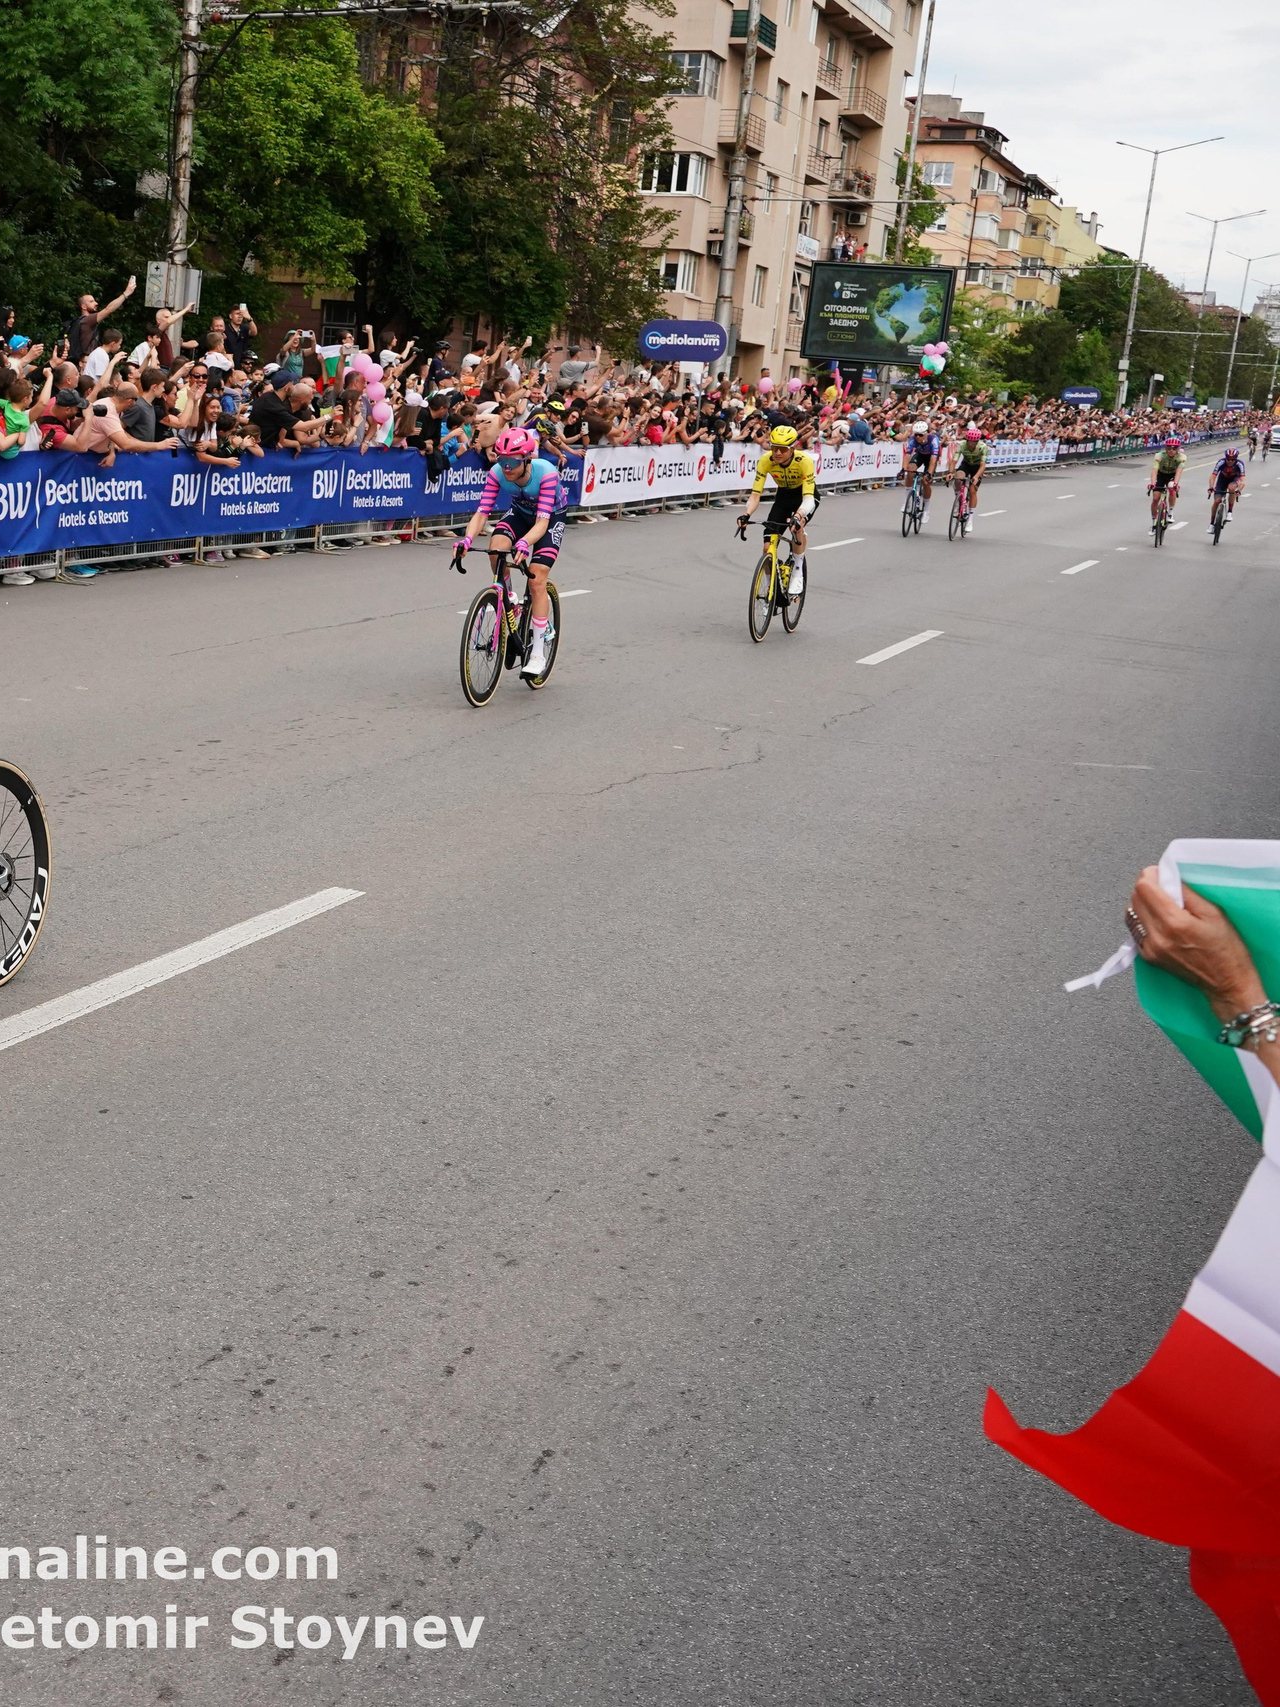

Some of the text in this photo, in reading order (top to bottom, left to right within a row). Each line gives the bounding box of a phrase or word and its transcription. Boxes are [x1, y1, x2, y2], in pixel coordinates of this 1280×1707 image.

[823, 304, 868, 314] ОТГОВОРНИ
[828, 318, 859, 328] ЗАЕДНО
[648, 333, 720, 347] mediolanum
[657, 461, 694, 479] CASTELLI
[823, 456, 848, 470] CASTELLI
[210, 472, 240, 496] Best
[312, 468, 339, 499] BW
[346, 468, 372, 490] Best
[446, 466, 464, 486] Best
[599, 466, 645, 485] CASTELLI
[45, 479, 79, 506] Best
[170, 473, 202, 507] BW
[220, 501, 280, 516] Hotels & Resorts
[353, 495, 404, 508] Hotels & Resorts
[58, 509, 129, 528] Hotels & Resorts
